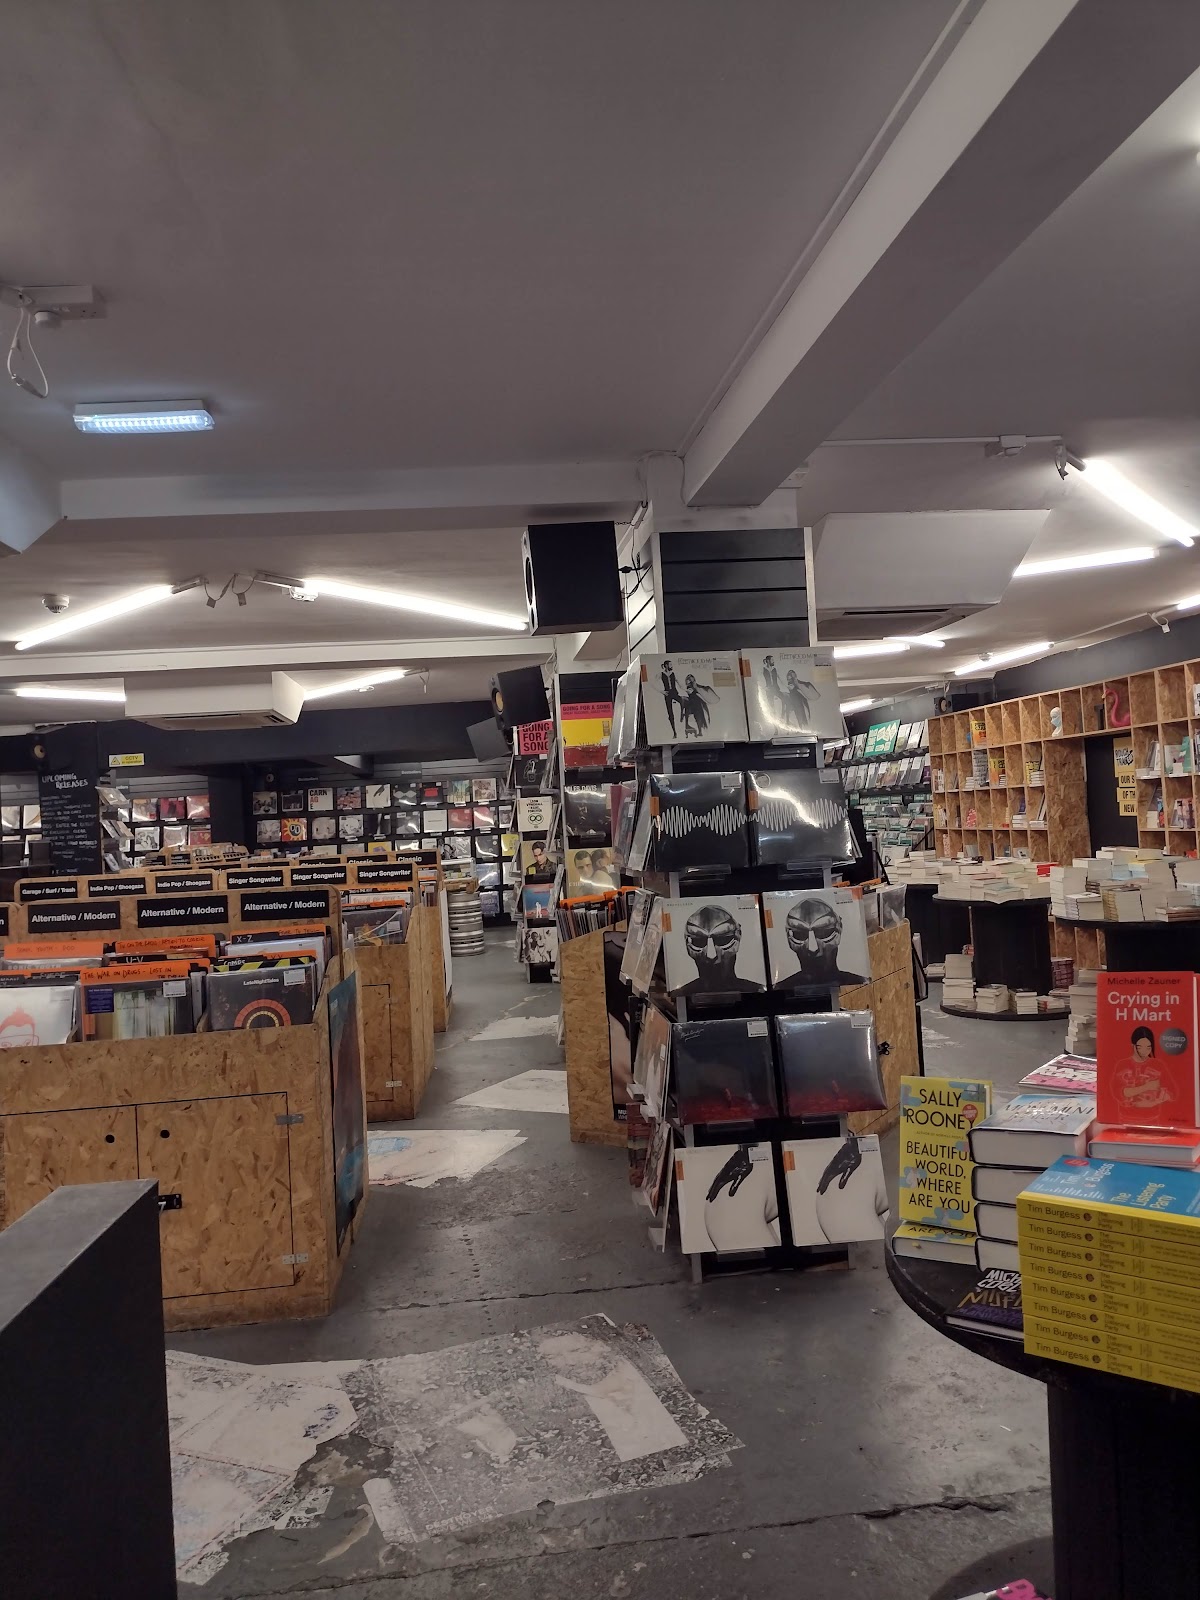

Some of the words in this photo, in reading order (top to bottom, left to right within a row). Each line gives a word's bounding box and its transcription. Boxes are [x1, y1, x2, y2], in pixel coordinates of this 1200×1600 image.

[522, 722, 550, 732] GOING
[524, 733, 540, 742] FOR
[42, 773, 77, 783] UPCOMING
[1121, 776, 1131, 784] OUR
[56, 779, 88, 790] RELEASES
[1123, 791, 1129, 799] OF
[1124, 804, 1134, 813] NEW
[249, 876, 282, 884] Songwriter
[313, 872, 345, 880] Songwriter
[244, 902, 288, 911] Alternative
[294, 900, 325, 909] Modern
[32, 913, 76, 923] Alternative
[84, 912, 116, 920] Modern
[141, 908, 186, 918] Alternative
[192, 906, 224, 914] Modern
[236, 935, 254, 943] X-Z
[97, 971, 110, 979] WAR
[123, 969, 141, 978] DRUGS
[1148, 977, 1181, 985] Zauner
[1108, 991, 1161, 1008] Crying
[1166, 991, 1180, 1004] in
[1116, 1008, 1128, 1021] H
[1133, 1008, 1172, 1022] Mart
[919, 1089, 962, 1108] SALLY
[916, 1159, 966, 1179] WORLD,
[917, 1178, 962, 1195] WHERE
[909, 1192, 933, 1208] ARE
[940, 1196, 970, 1214] YOU
[1028, 1204, 1043, 1214] Tim
[1046, 1206, 1080, 1220] Burgess
[1029, 1224, 1044, 1234] Tim
[1047, 1227, 1082, 1240] Burgess
[1029, 1243, 1044, 1252] Tim
[1047, 1246, 1082, 1260] Burgess
[1030, 1263, 1046, 1272] Tim
[1048, 1266, 1083, 1280] Burgess
[1032, 1283, 1049, 1292] Tim
[1051, 1287, 1086, 1300] Burgess
[1034, 1302, 1049, 1312] Tim
[1052, 1306, 1086, 1321] Burgess
[1036, 1324, 1051, 1333] Tim
[1054, 1328, 1089, 1342] Burgess
[1036, 1342, 1050, 1352] Tim
[1054, 1347, 1089, 1362] Burgess
